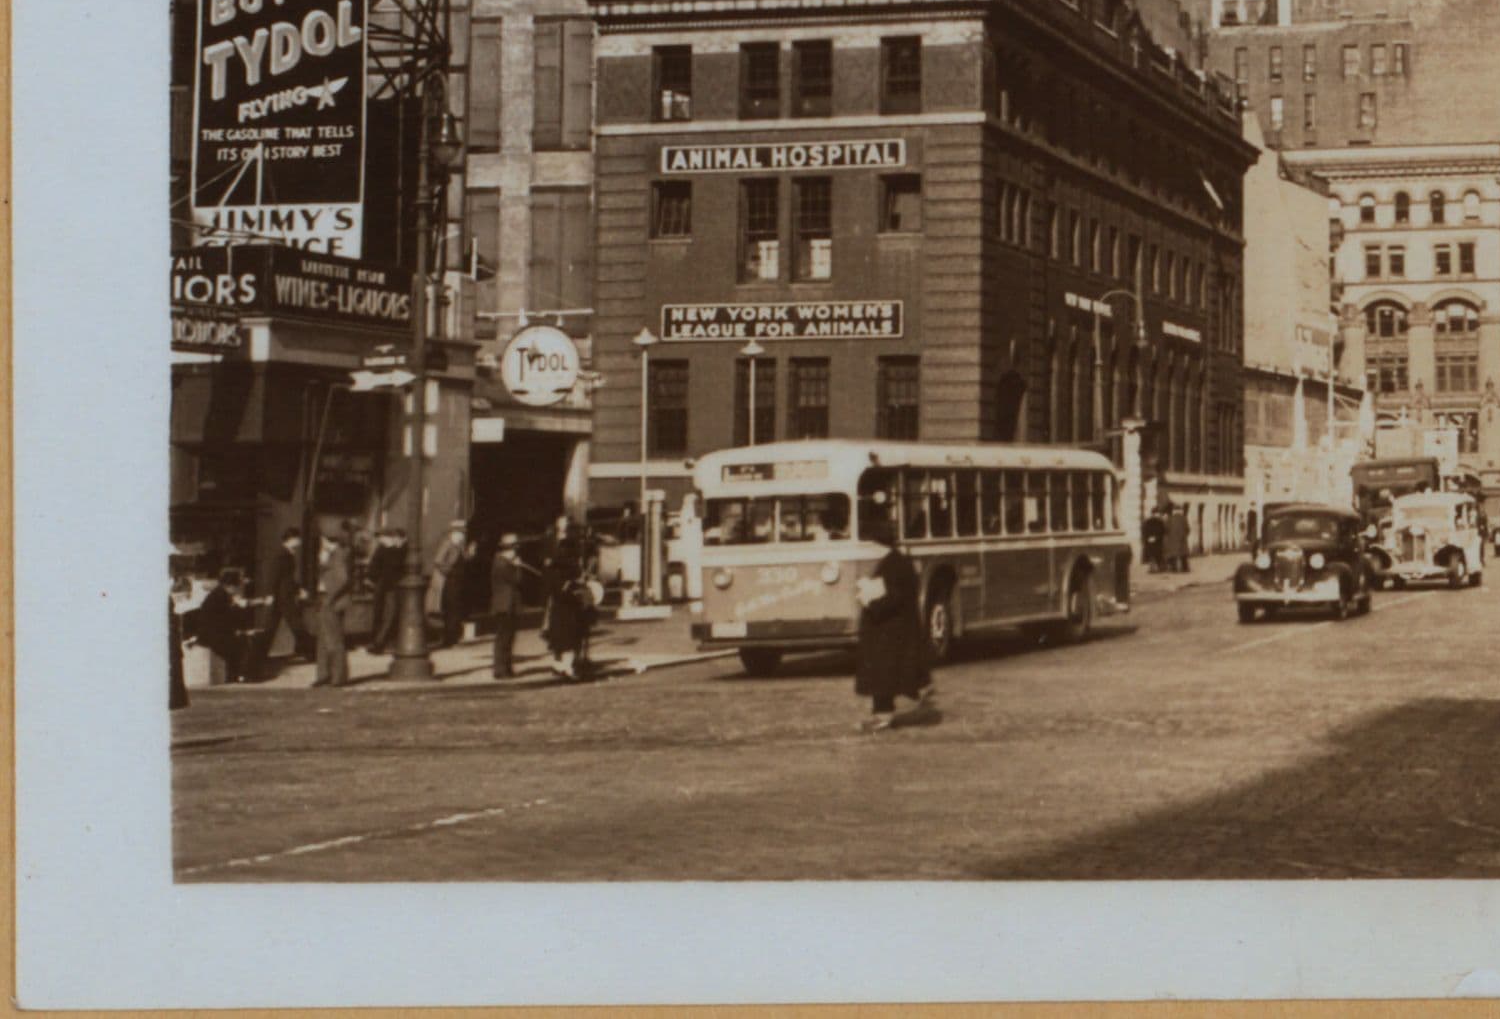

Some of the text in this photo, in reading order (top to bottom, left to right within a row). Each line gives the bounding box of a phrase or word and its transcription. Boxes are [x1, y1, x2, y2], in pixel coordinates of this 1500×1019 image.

[237, 85, 308, 124] FLYING
[202, 124, 355, 142] THE GASOLINE THAT TELLS
[216, 147, 238, 162] ITS
[271, 145, 309, 160] STORY
[311, 143, 343, 158] BEST
[671, 142, 896, 170] ANIMAL HOSPITAL
[671, 303, 893, 322] NEW YORK WOMEN'S
[671, 320, 893, 339] LEAGUE FOR ANIMALS
